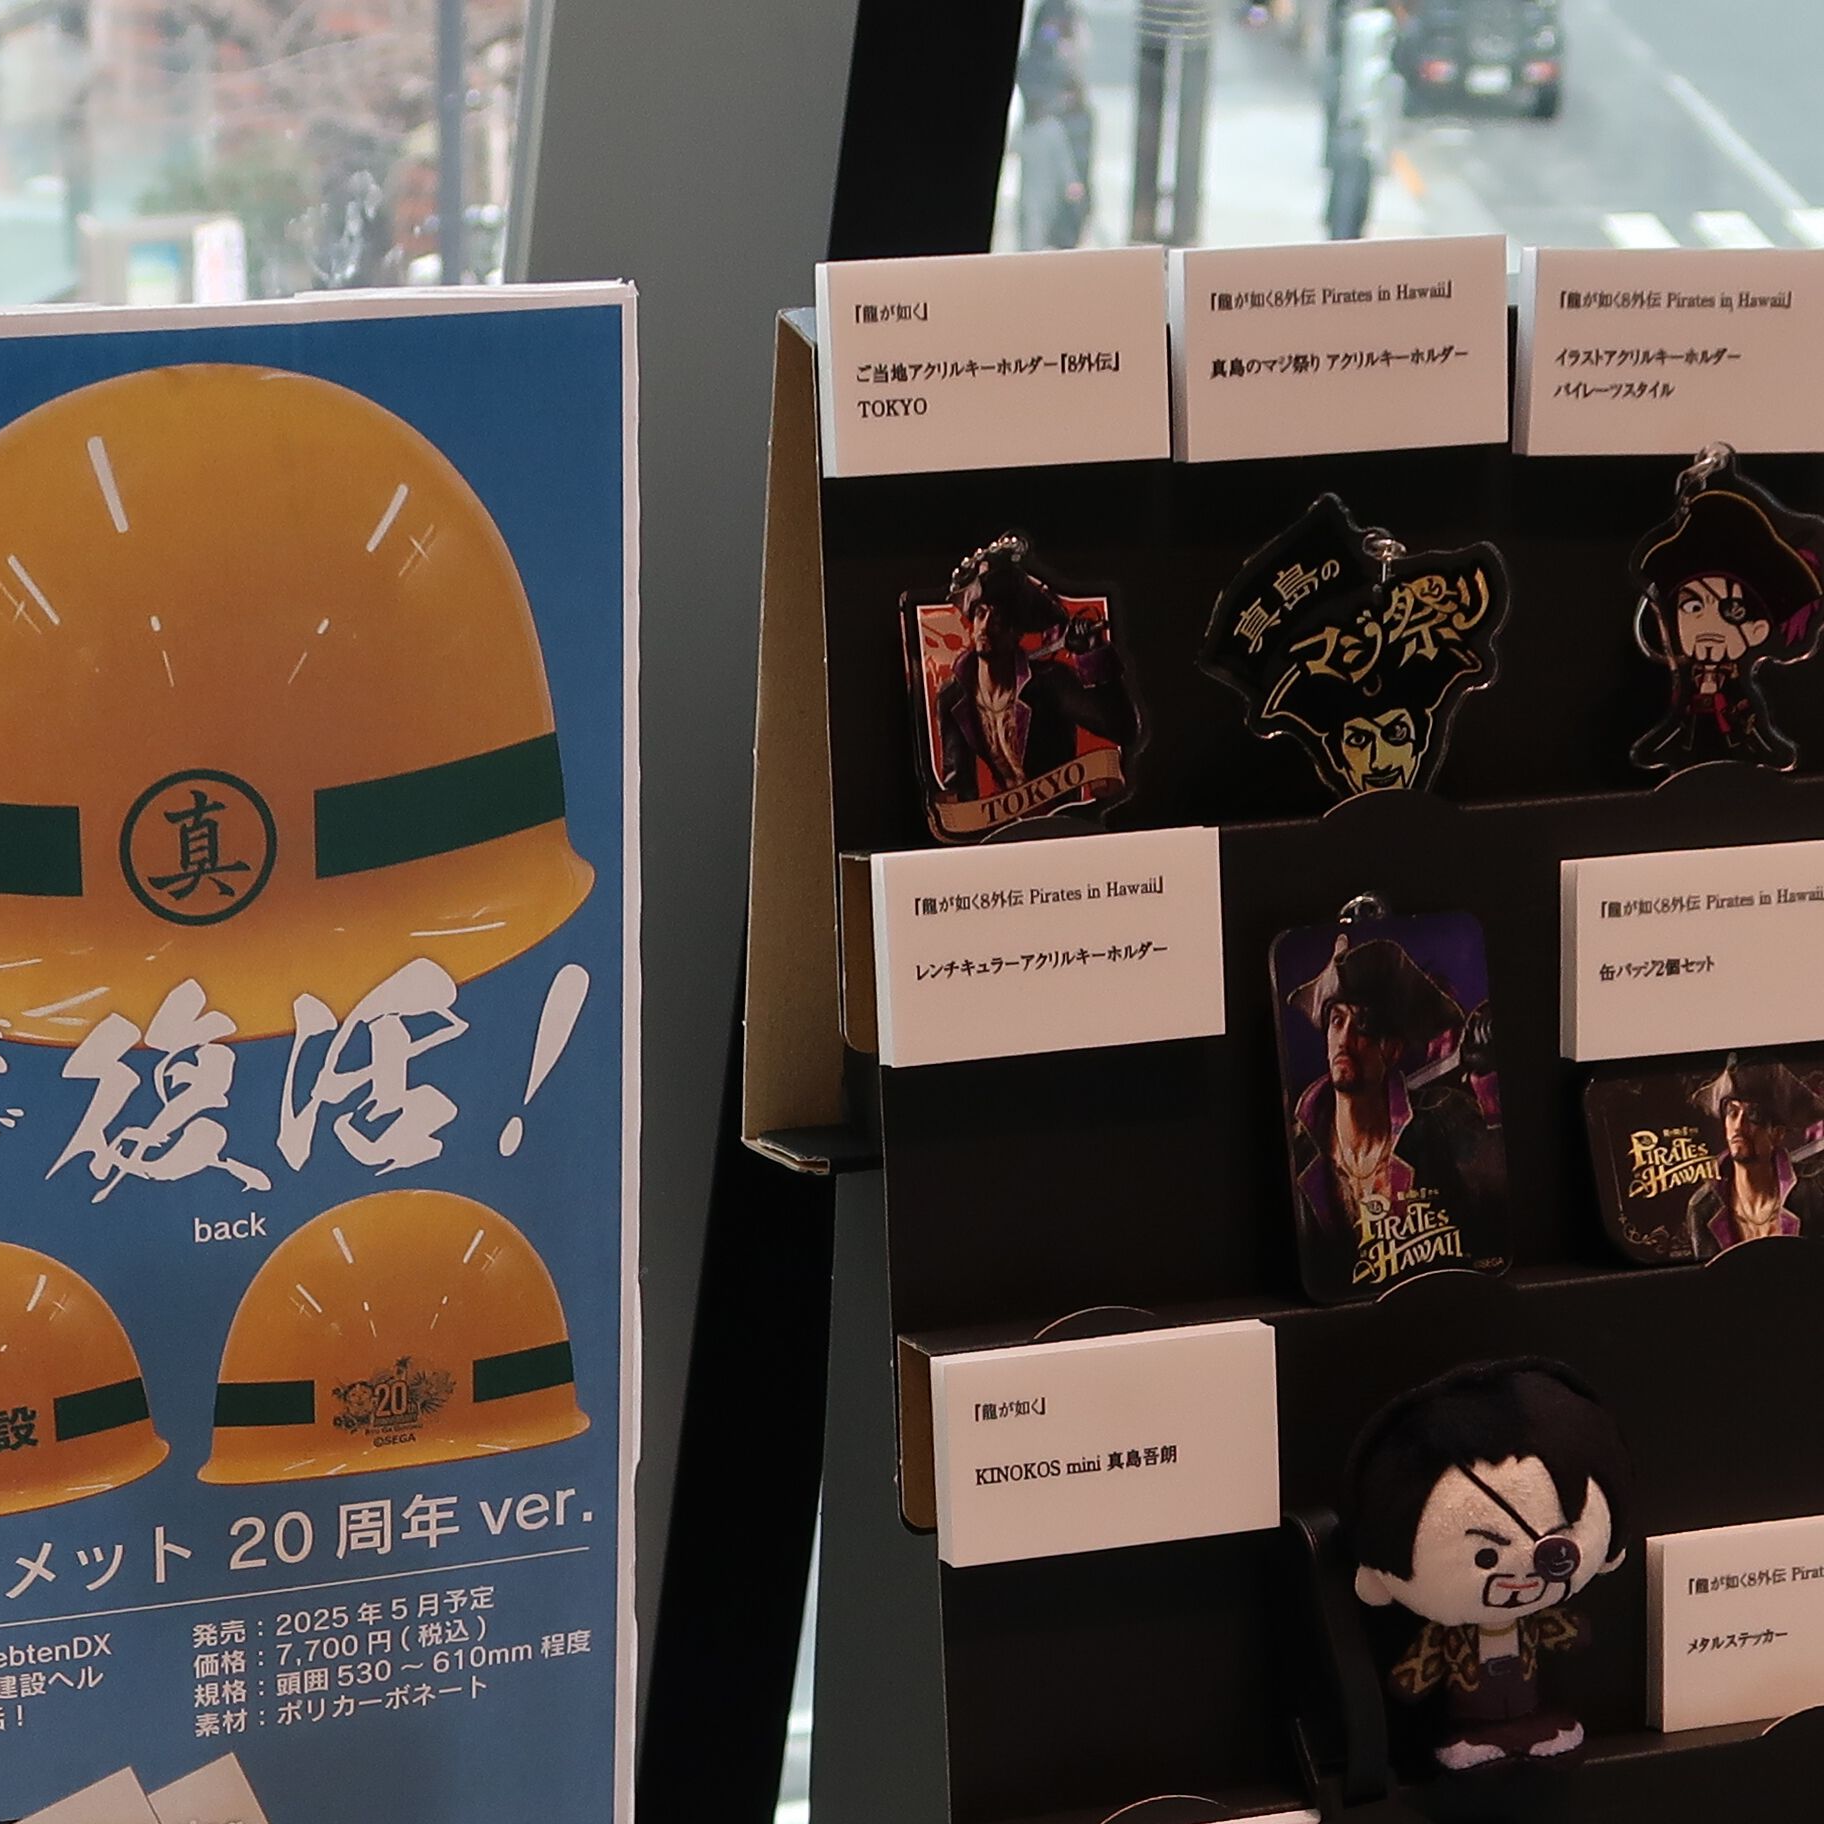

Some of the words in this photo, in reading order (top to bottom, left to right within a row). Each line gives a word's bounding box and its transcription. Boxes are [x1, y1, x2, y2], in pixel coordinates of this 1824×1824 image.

[1322, 283, 1372, 305] Pirates
[1378, 283, 1390, 301] in
[1667, 290, 1715, 309] Pirates
[1720, 291, 1733, 311] in
[854, 302, 928, 324] 『龍が如く』
[856, 352, 1120, 384] ご当地アクリルキーホルダー『8外伝』
[1209, 353, 1321, 380] 真島のマジ祭り
[1325, 345, 1469, 373] アクリルキーホルダー
[1554, 346, 1742, 367] イラストアクリルキーホルダー
[1553, 380, 1676, 399] パイレーツスタイル
[858, 397, 928, 419] TOKYO
[979, 760, 1088, 826] TOKYO
[147, 790, 251, 897] 真
[1030, 882, 1082, 906] Pirates
[1087, 882, 1101, 901] in
[1706, 890, 1755, 910] Pirates
[1759, 889, 1772, 906] in
[915, 942, 1169, 983] レンチキュラーアクリルキーホルダー
[1599, 955, 1716, 983] 缶バッジ2個セット
[1628, 1131, 1708, 1171] PIRATES
[193, 1211, 268, 1244] back
[1354, 1193, 1450, 1249] PIRATES
[975, 1397, 1046, 1422] 『龍が如く』
[976, 1458, 1061, 1487] KINOKOS
[1066, 1453, 1101, 1476] mini
[1107, 1444, 1178, 1473] 真島吾朗
[229, 1511, 314, 1572] 20
[479, 1486, 594, 1537] ver.
[1686, 1626, 1789, 1655] メタルステッカー
